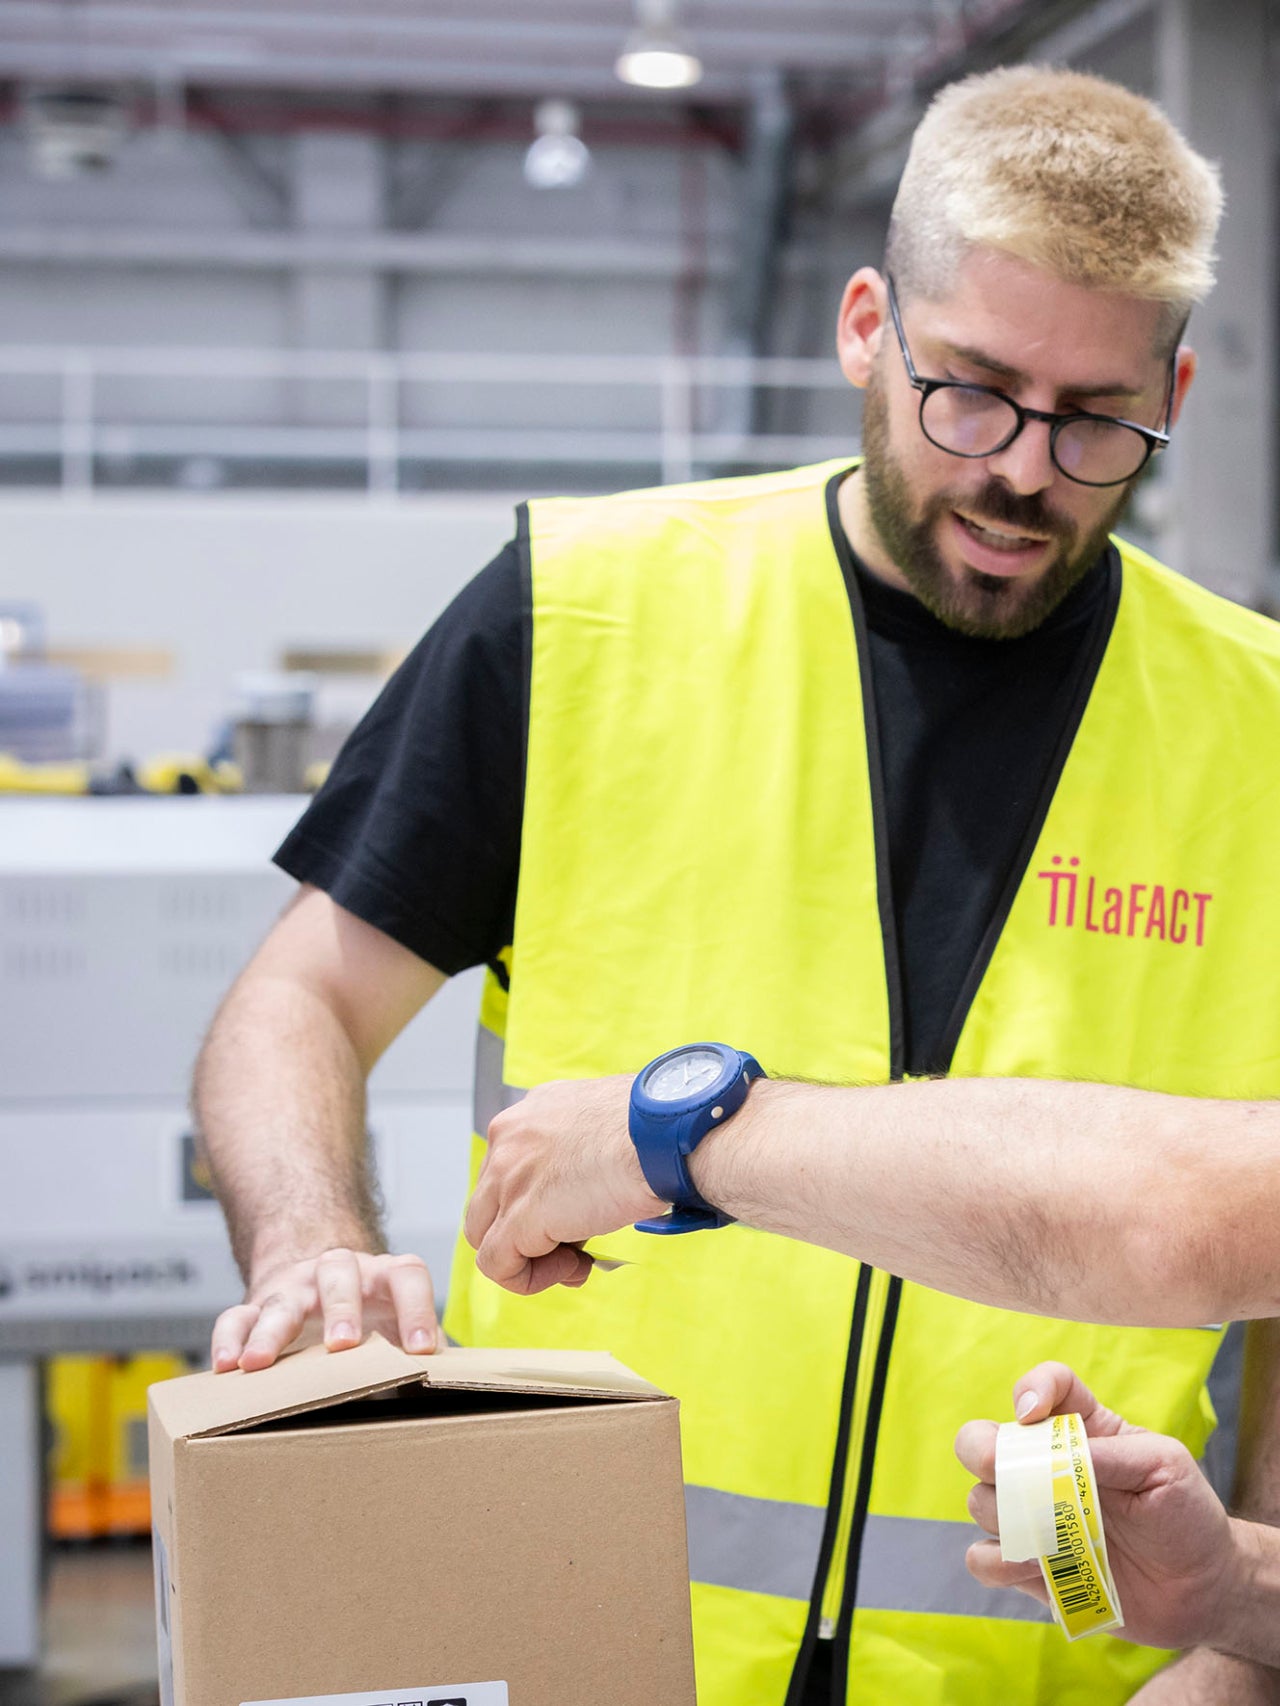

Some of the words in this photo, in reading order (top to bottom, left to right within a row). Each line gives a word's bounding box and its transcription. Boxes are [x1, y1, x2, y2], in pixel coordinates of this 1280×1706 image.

[1085, 876, 1213, 947] LaFACT
[1062, 1504, 1086, 1556] 001580
[1079, 1560, 1102, 1602] 429603
